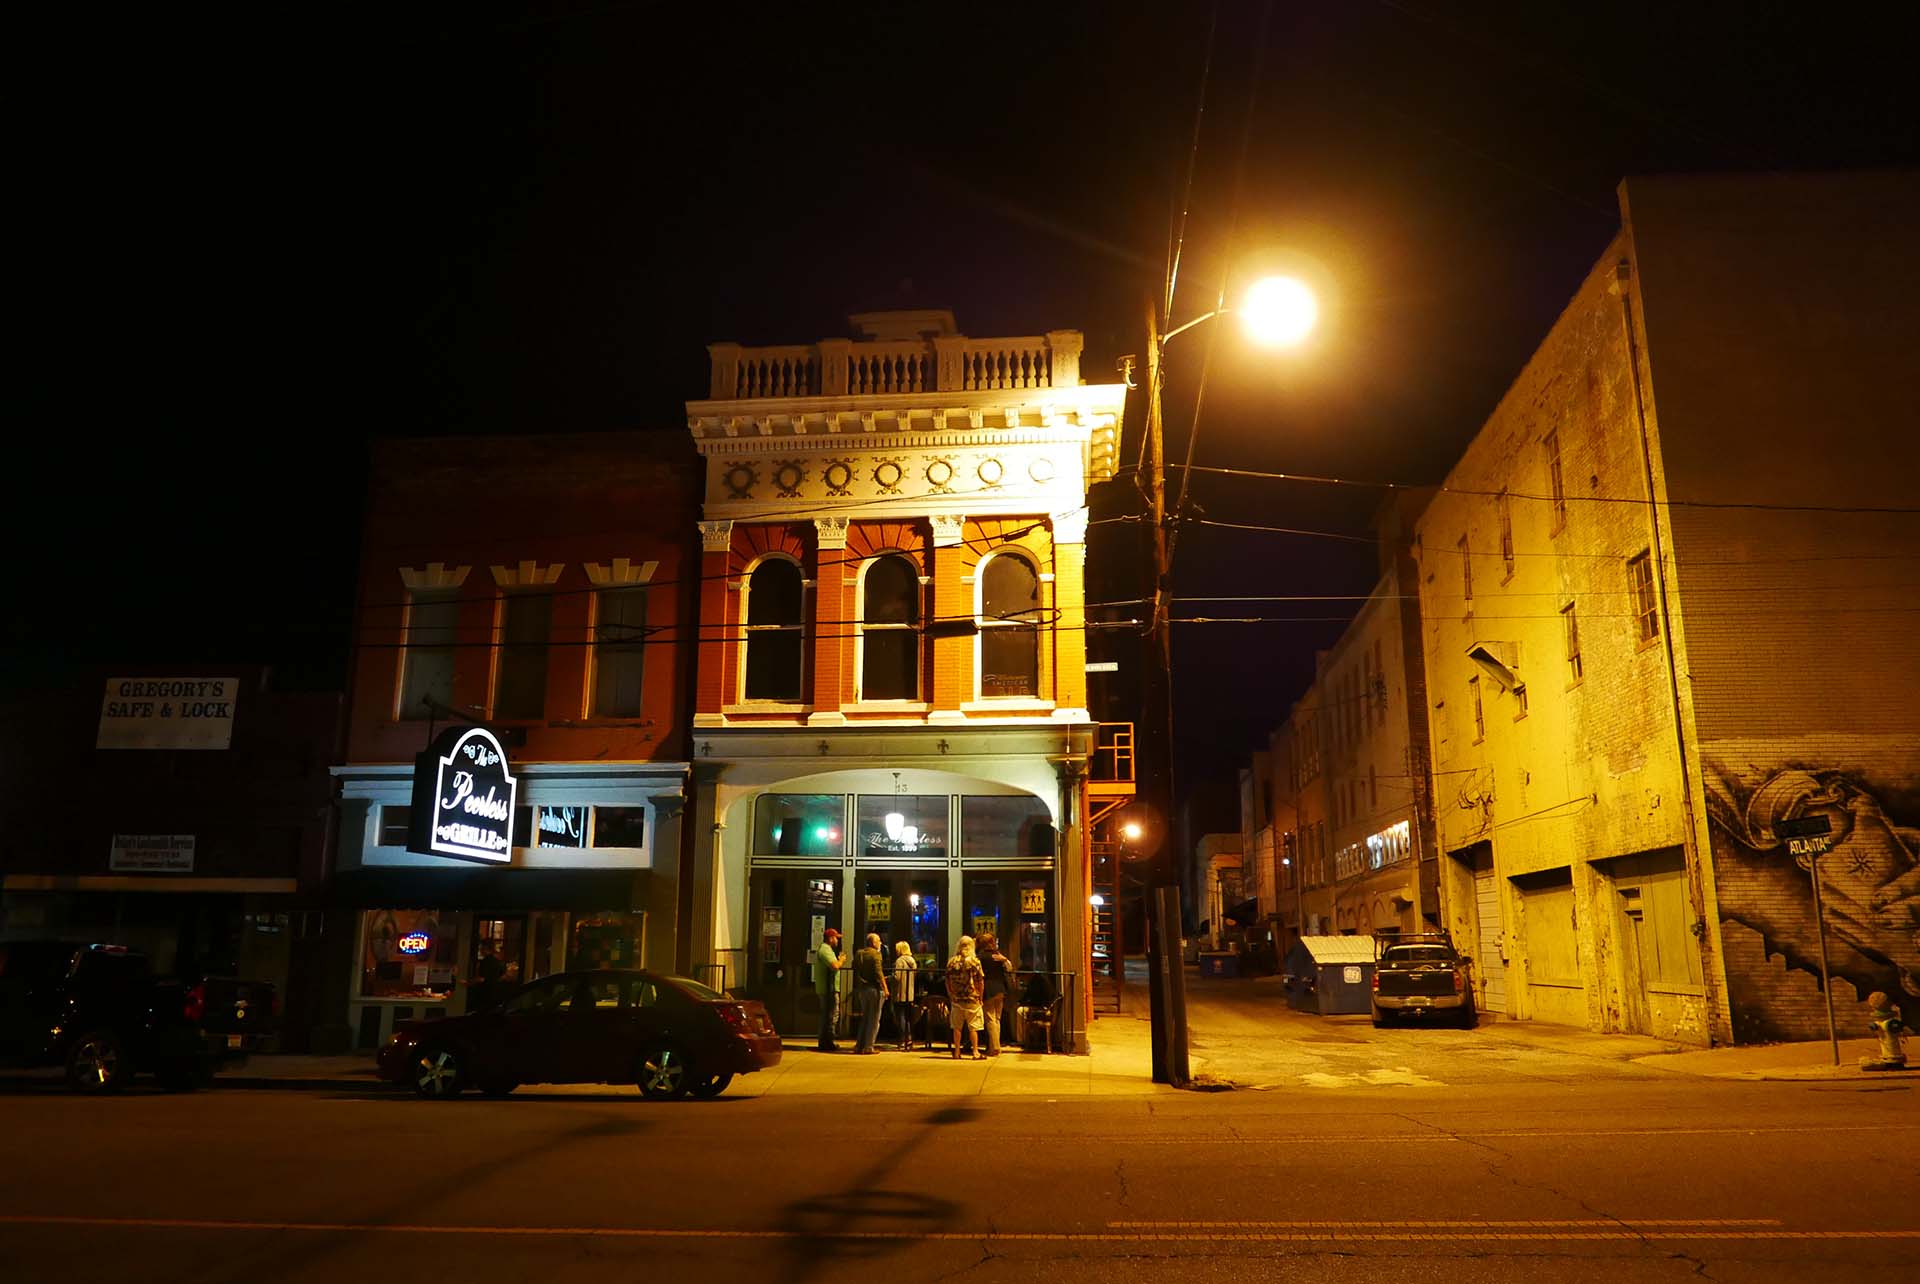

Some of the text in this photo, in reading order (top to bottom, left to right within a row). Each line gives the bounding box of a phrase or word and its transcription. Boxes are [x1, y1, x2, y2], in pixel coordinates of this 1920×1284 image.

[120, 681, 224, 697] GREGORY'S
[107, 702, 231, 718] SAFE & LOCK
[441, 770, 508, 821] Peerless
[450, 822, 498, 849] GRILLE
[399, 938, 428, 950] OPEN
